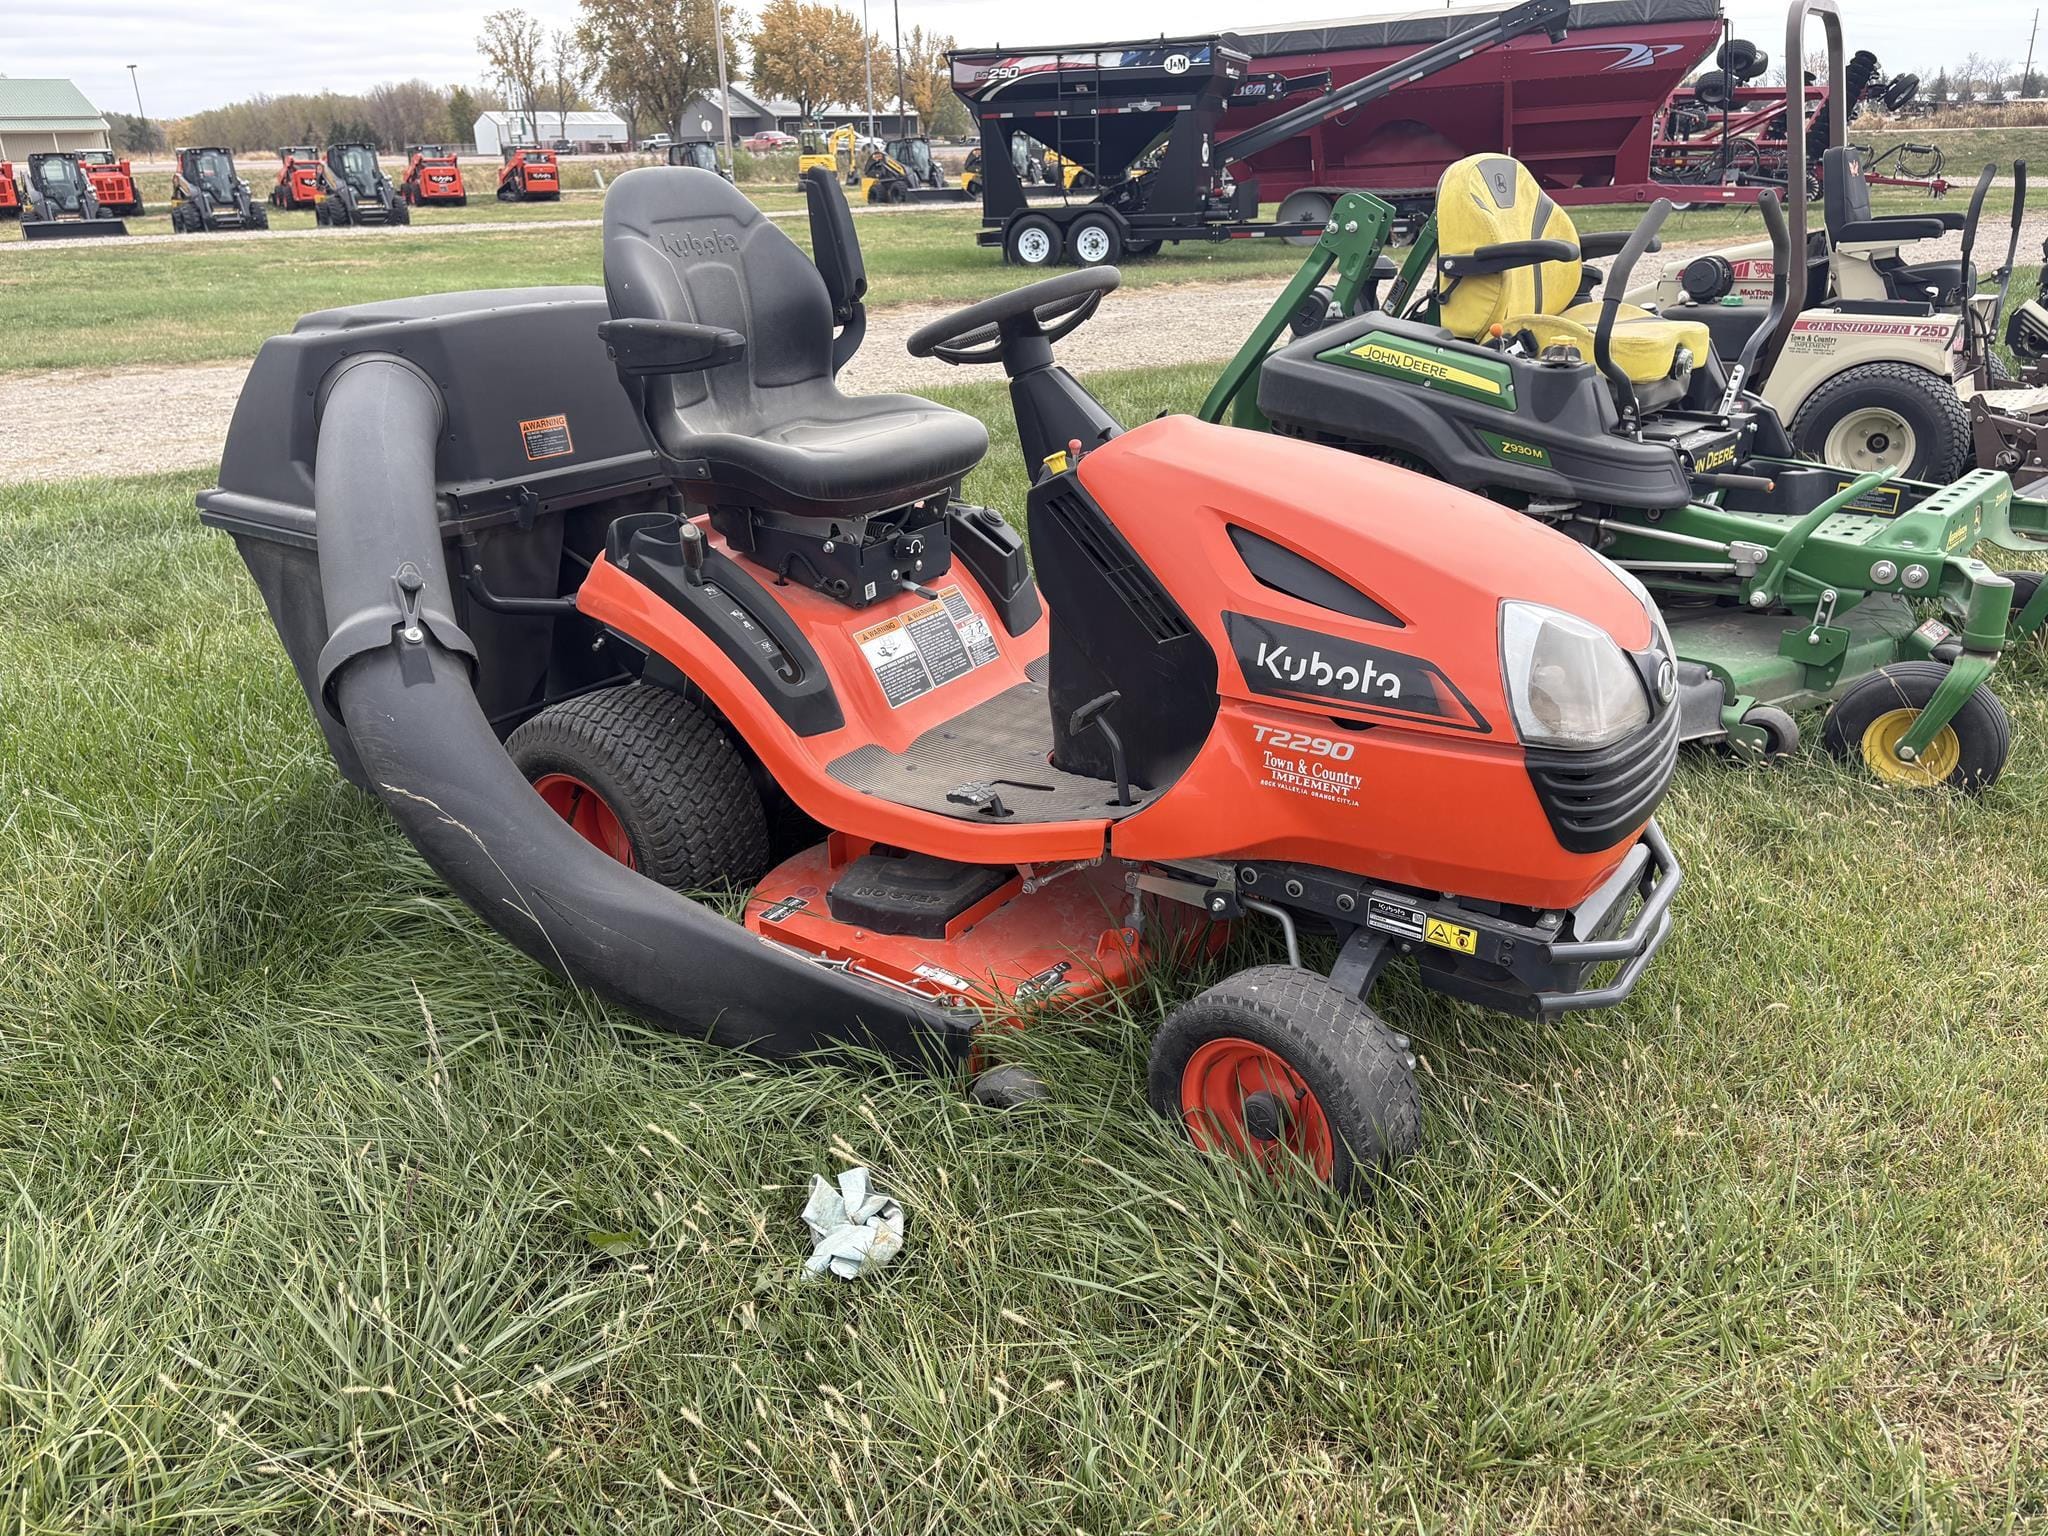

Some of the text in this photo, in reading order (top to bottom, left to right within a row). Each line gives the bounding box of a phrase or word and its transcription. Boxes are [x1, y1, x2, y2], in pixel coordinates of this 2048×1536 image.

[1165, 58, 1186, 71] J&M
[660, 229, 739, 257] Kubota
[1807, 321, 1950, 338] GRASSHOPPER 725D
[1814, 334, 1837, 346] Country
[1364, 346, 1448, 379] JOHN DEERE
[528, 417, 565, 430] WARNING
[1501, 441, 1543, 459] Z930M
[1706, 444, 1736, 470] DEERE
[868, 621, 896, 638] WARNING
[1256, 642, 1401, 699] Kubota
[1253, 724, 1355, 761] T2290
[1263, 750, 1362, 789] Town & Country
[1260, 779, 1277, 788] ROCK
[1311, 790, 1336, 803] ORANGE
[1271, 770, 1350, 797] IMPLEMENT
[852, 886, 888, 897] NO
[1378, 902, 1406, 916] Kubota
